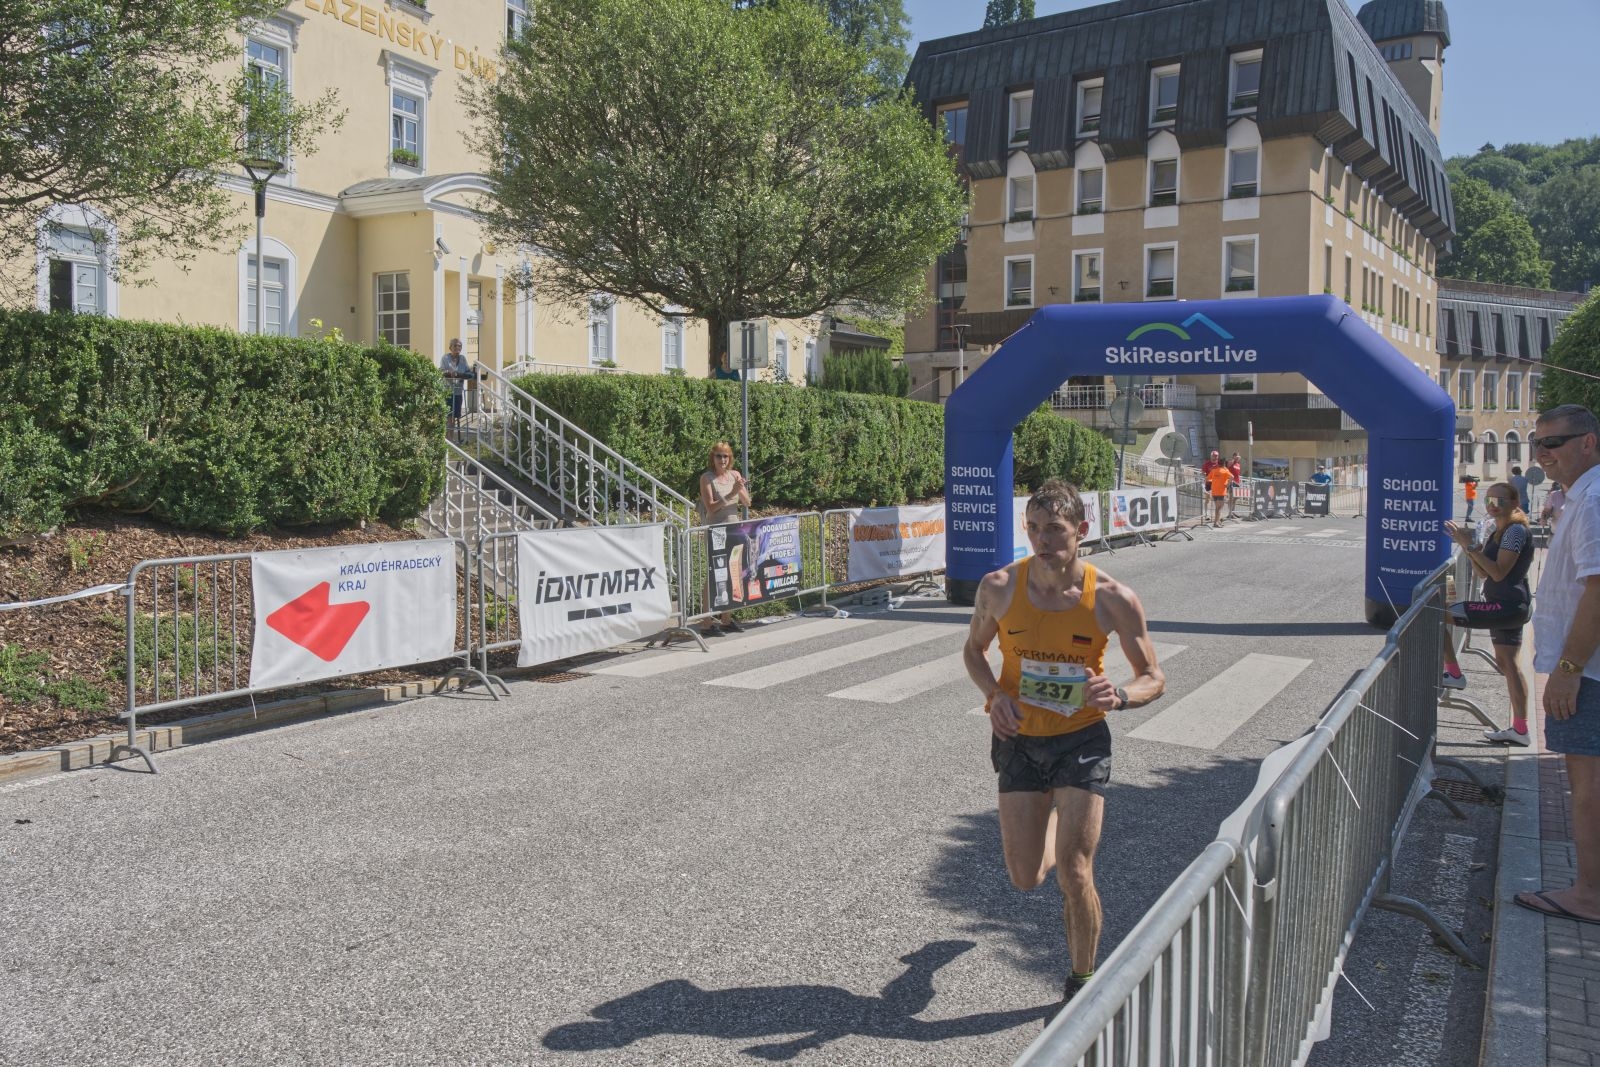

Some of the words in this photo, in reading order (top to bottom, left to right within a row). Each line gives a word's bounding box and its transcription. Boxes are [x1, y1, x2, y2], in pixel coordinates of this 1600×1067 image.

[1105, 345, 1257, 364] SkiResortLive
[951, 466, 996, 478] SCHOOL
[952, 484, 994, 496] RENTAL
[1382, 478, 1440, 492] SCHOOL
[951, 502, 997, 514] SERVICE
[1128, 490, 1175, 527] CÍL
[1384, 498, 1437, 512] RENTAL
[953, 520, 995, 532] EVENTS
[1381, 518, 1439, 532] SERVICE
[1383, 538, 1436, 552] EVENTS
[340, 555, 442, 576] KRÁLOVÉHRADECKÝ
[338, 579, 367, 593] KRAJ
[1012, 646, 1088, 665] GERMANY
[1035, 681, 1074, 701] 237
